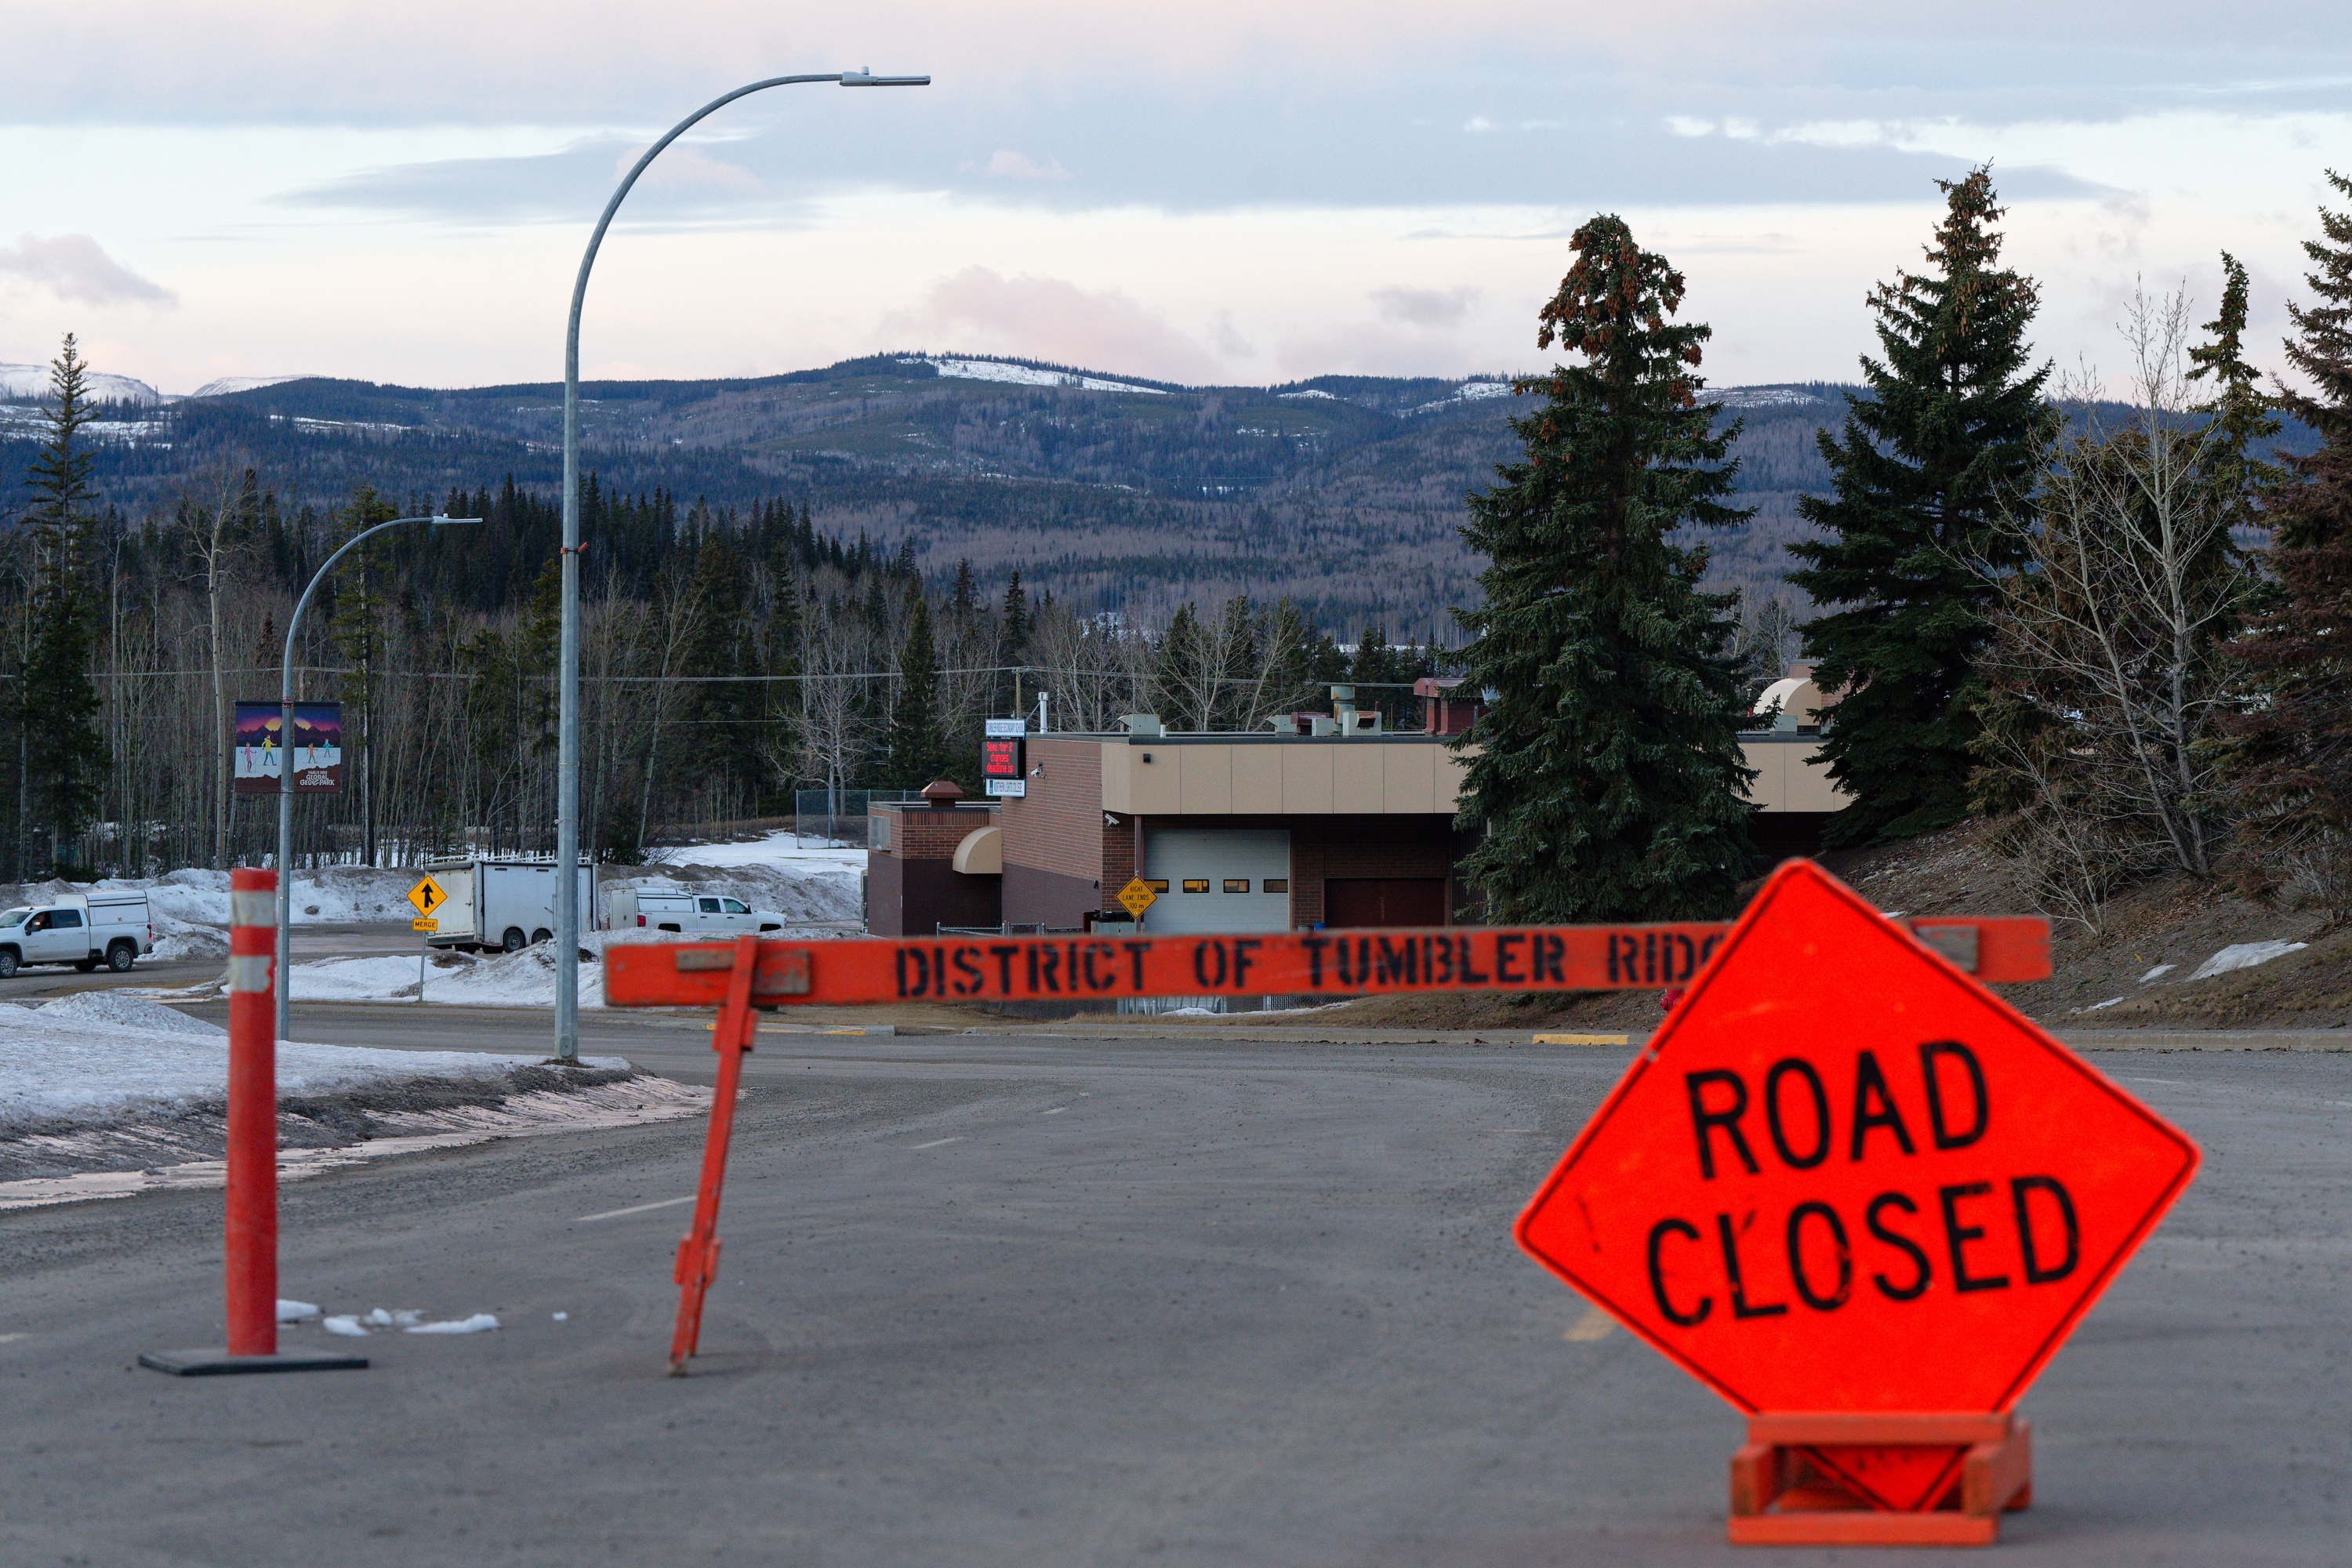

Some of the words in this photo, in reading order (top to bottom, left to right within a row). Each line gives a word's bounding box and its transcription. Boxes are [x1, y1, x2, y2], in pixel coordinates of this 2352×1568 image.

[1008, 742, 1013, 752] 2
[895, 941, 1152, 997] DISTRICT
[1193, 939, 1261, 988] OF
[1300, 935, 1566, 987] TUMBLER
[1685, 1040, 1989, 1180] ROAD
[1647, 1174, 2081, 1327] CLOSED
